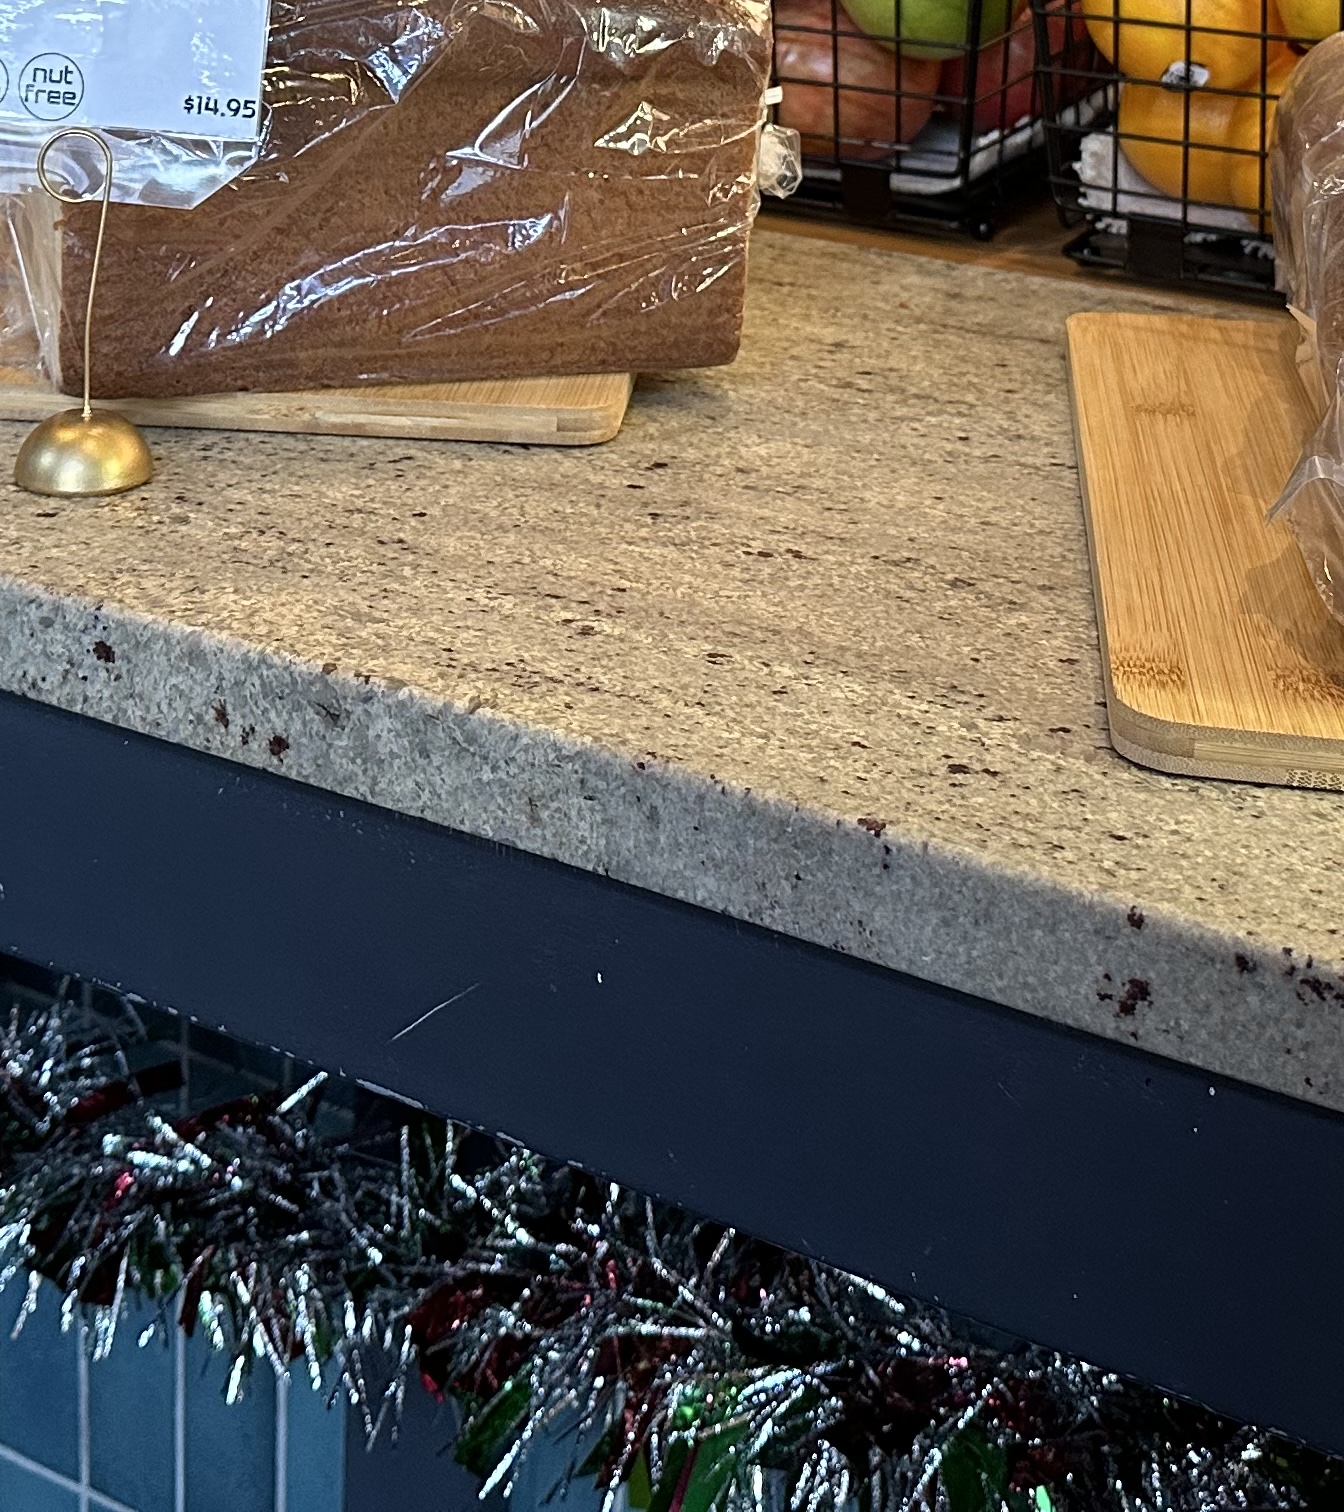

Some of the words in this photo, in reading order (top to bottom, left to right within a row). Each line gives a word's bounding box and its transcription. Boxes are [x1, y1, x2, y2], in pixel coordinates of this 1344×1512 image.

[32, 65, 73, 85] nut
[24, 84, 77, 106] free
[183, 95, 256, 119] $14.95
